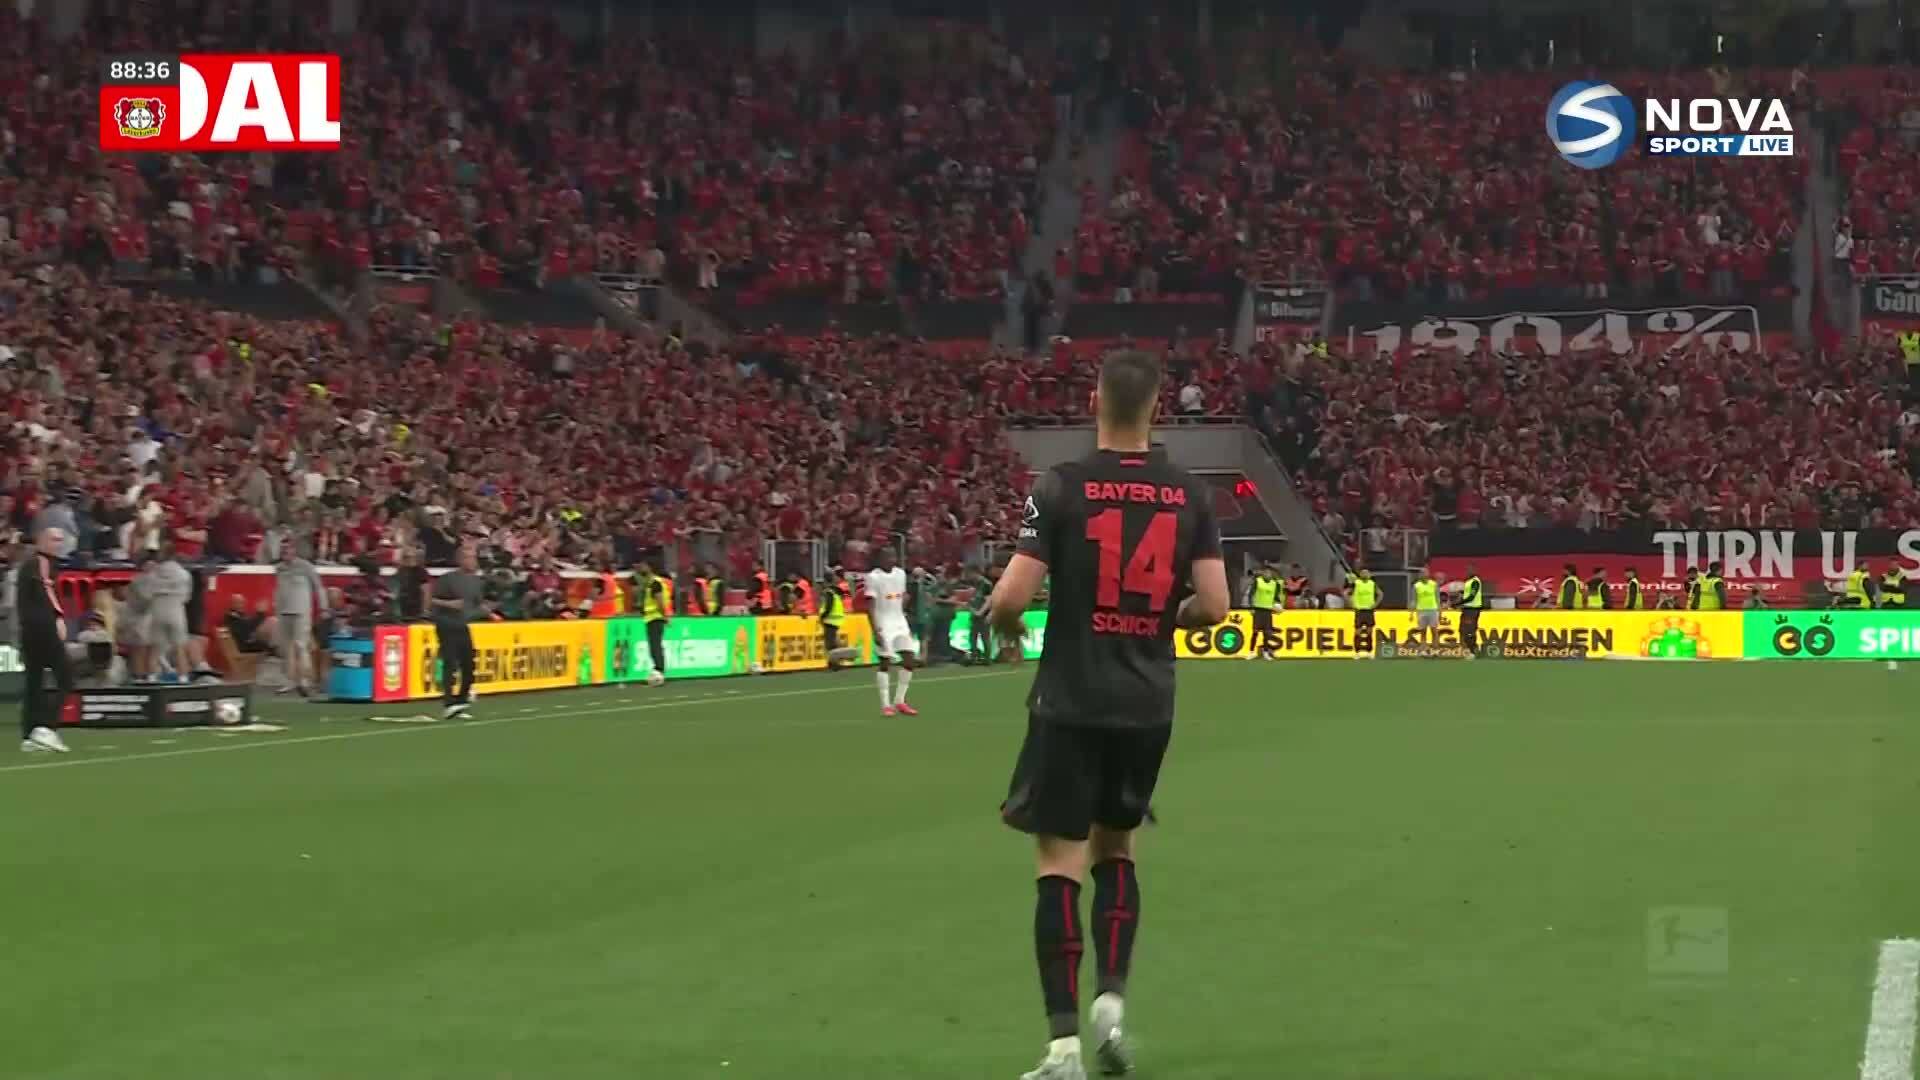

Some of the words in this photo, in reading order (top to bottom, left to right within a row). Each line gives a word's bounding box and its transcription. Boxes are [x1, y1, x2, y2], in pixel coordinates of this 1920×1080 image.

[1084, 481, 1156, 502] BAYER
[1161, 488, 1186, 505] 04
[1086, 508, 1177, 612] 14
[1653, 530, 1793, 578] TURN
[1821, 530, 1857, 578] U
[1092, 612, 1160, 635] SCHICK
